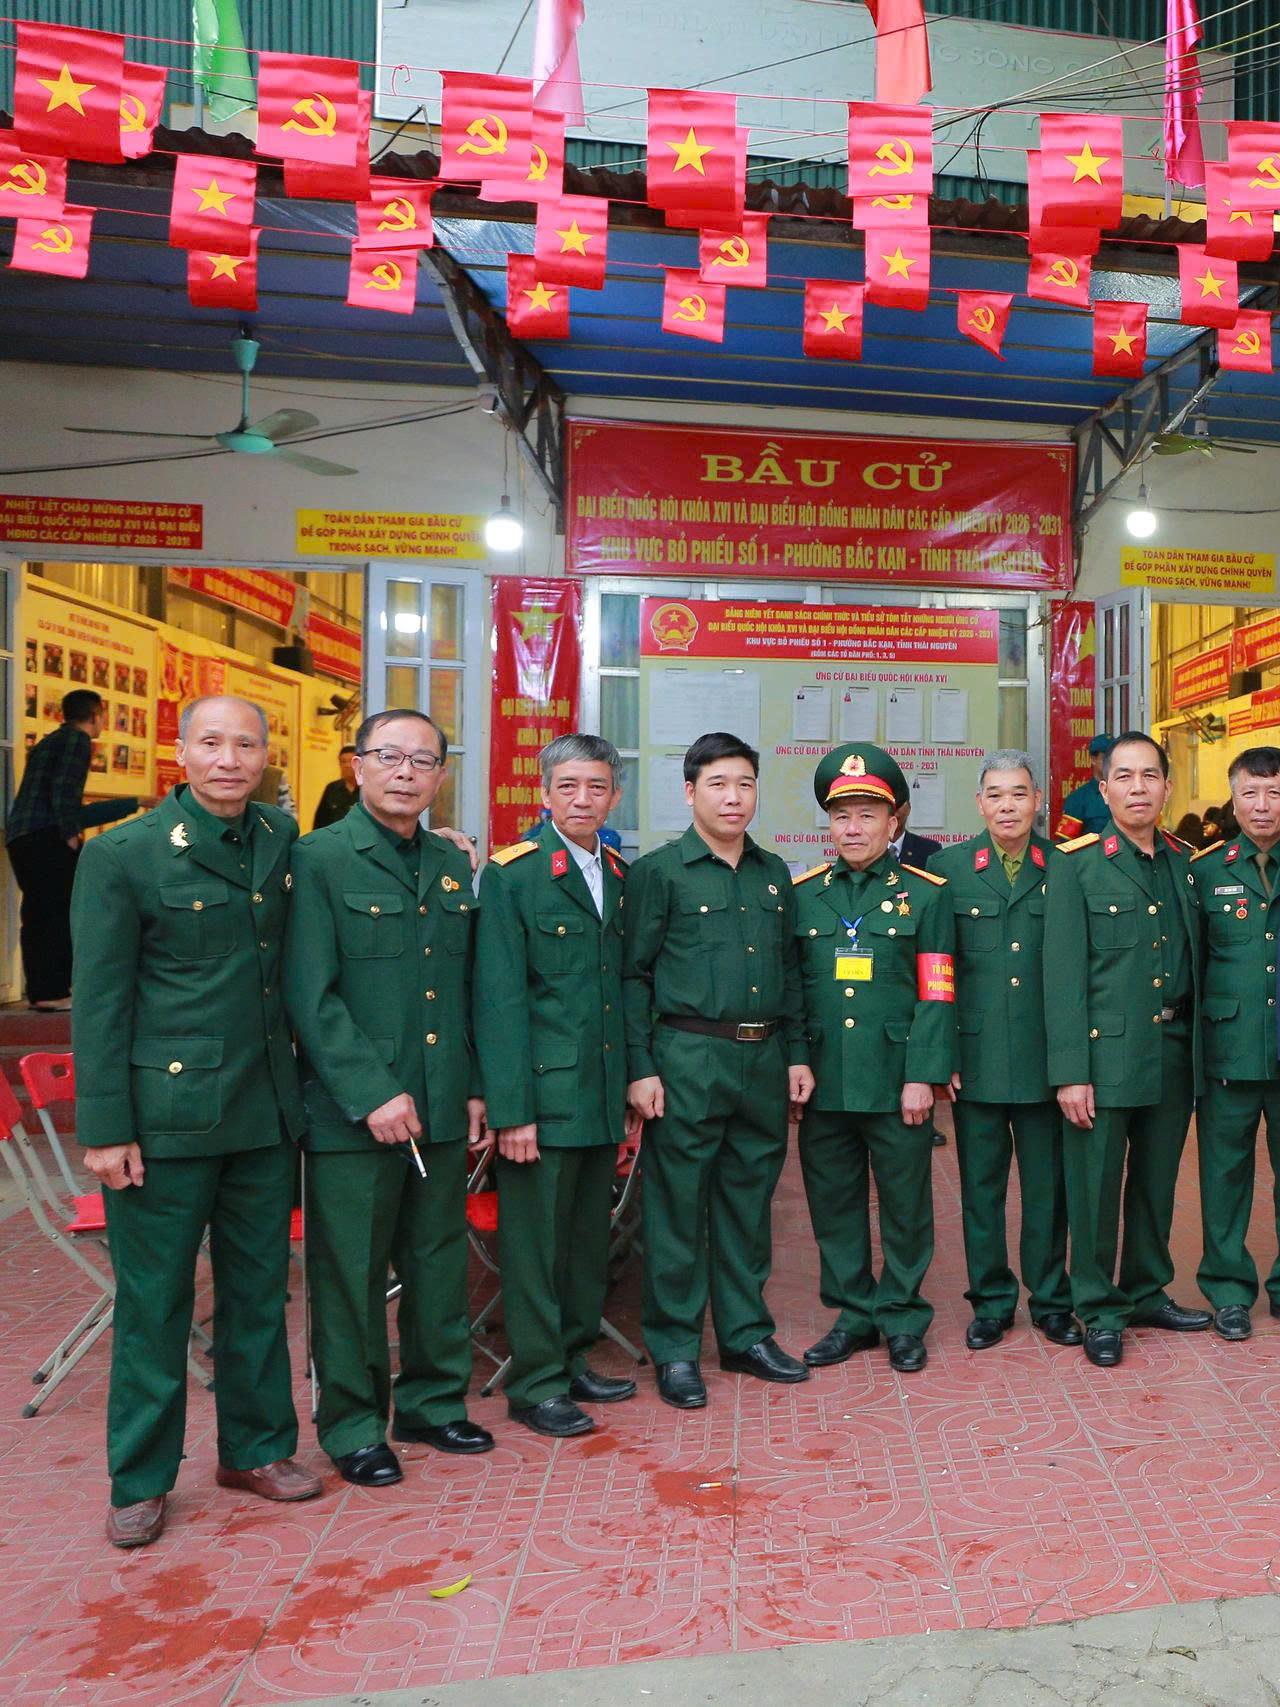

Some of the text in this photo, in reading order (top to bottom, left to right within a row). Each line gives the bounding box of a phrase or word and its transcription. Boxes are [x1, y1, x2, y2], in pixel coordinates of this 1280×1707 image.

[701, 441, 952, 491] BẦU CỬ
[577, 495, 597, 522] ĐẠI
[600, 489, 624, 519] BIỂU
[628, 490, 656, 520] QUỐC
[661, 494, 678, 525] HỘI
[681, 495, 710, 522] KHÓA
[713, 501, 730, 523] XVI
[734, 497, 747, 523] VÀ
[751, 502, 768, 528] ĐẠI
[771, 496, 796, 525] BIỂU
[799, 500, 816, 530] HỘI
[819, 499, 848, 527] ĐỒNG
[851, 503, 880, 529] NHÂN
[883, 504, 904, 530] DÂN
[908, 505, 928, 530] CÁC
[931, 503, 950, 531] CẤP
[989, 508, 1003, 533] KỲ
[1006, 513, 1029, 534] 2026
[1039, 515, 1062, 536] 2031
[601, 537, 630, 561] KHU
[635, 538, 663, 566] VỰC
[667, 535, 687, 562] BỎ
[691, 533, 734, 564] PHIẾU
[738, 535, 757, 564] SỐ
[762, 543, 768, 565] 1
[784, 538, 842, 569] PHƯỜNG
[845, 538, 874, 569] BẮC
[877, 547, 906, 574] KẠN
[920, 543, 951, 571] TỈNH
[1143, 550, 1255, 564] TOÀN DÂN THAM GIA BẦU CỬ
[1124, 561, 1272, 577] ĐỂ GÓP PHẦN XÂY DỰNG CHÍNH QUYỀN
[1069, 684, 1092, 706] TOÀN
[1070, 719, 1094, 736] THAM
[921, 762, 938, 770] 2031
